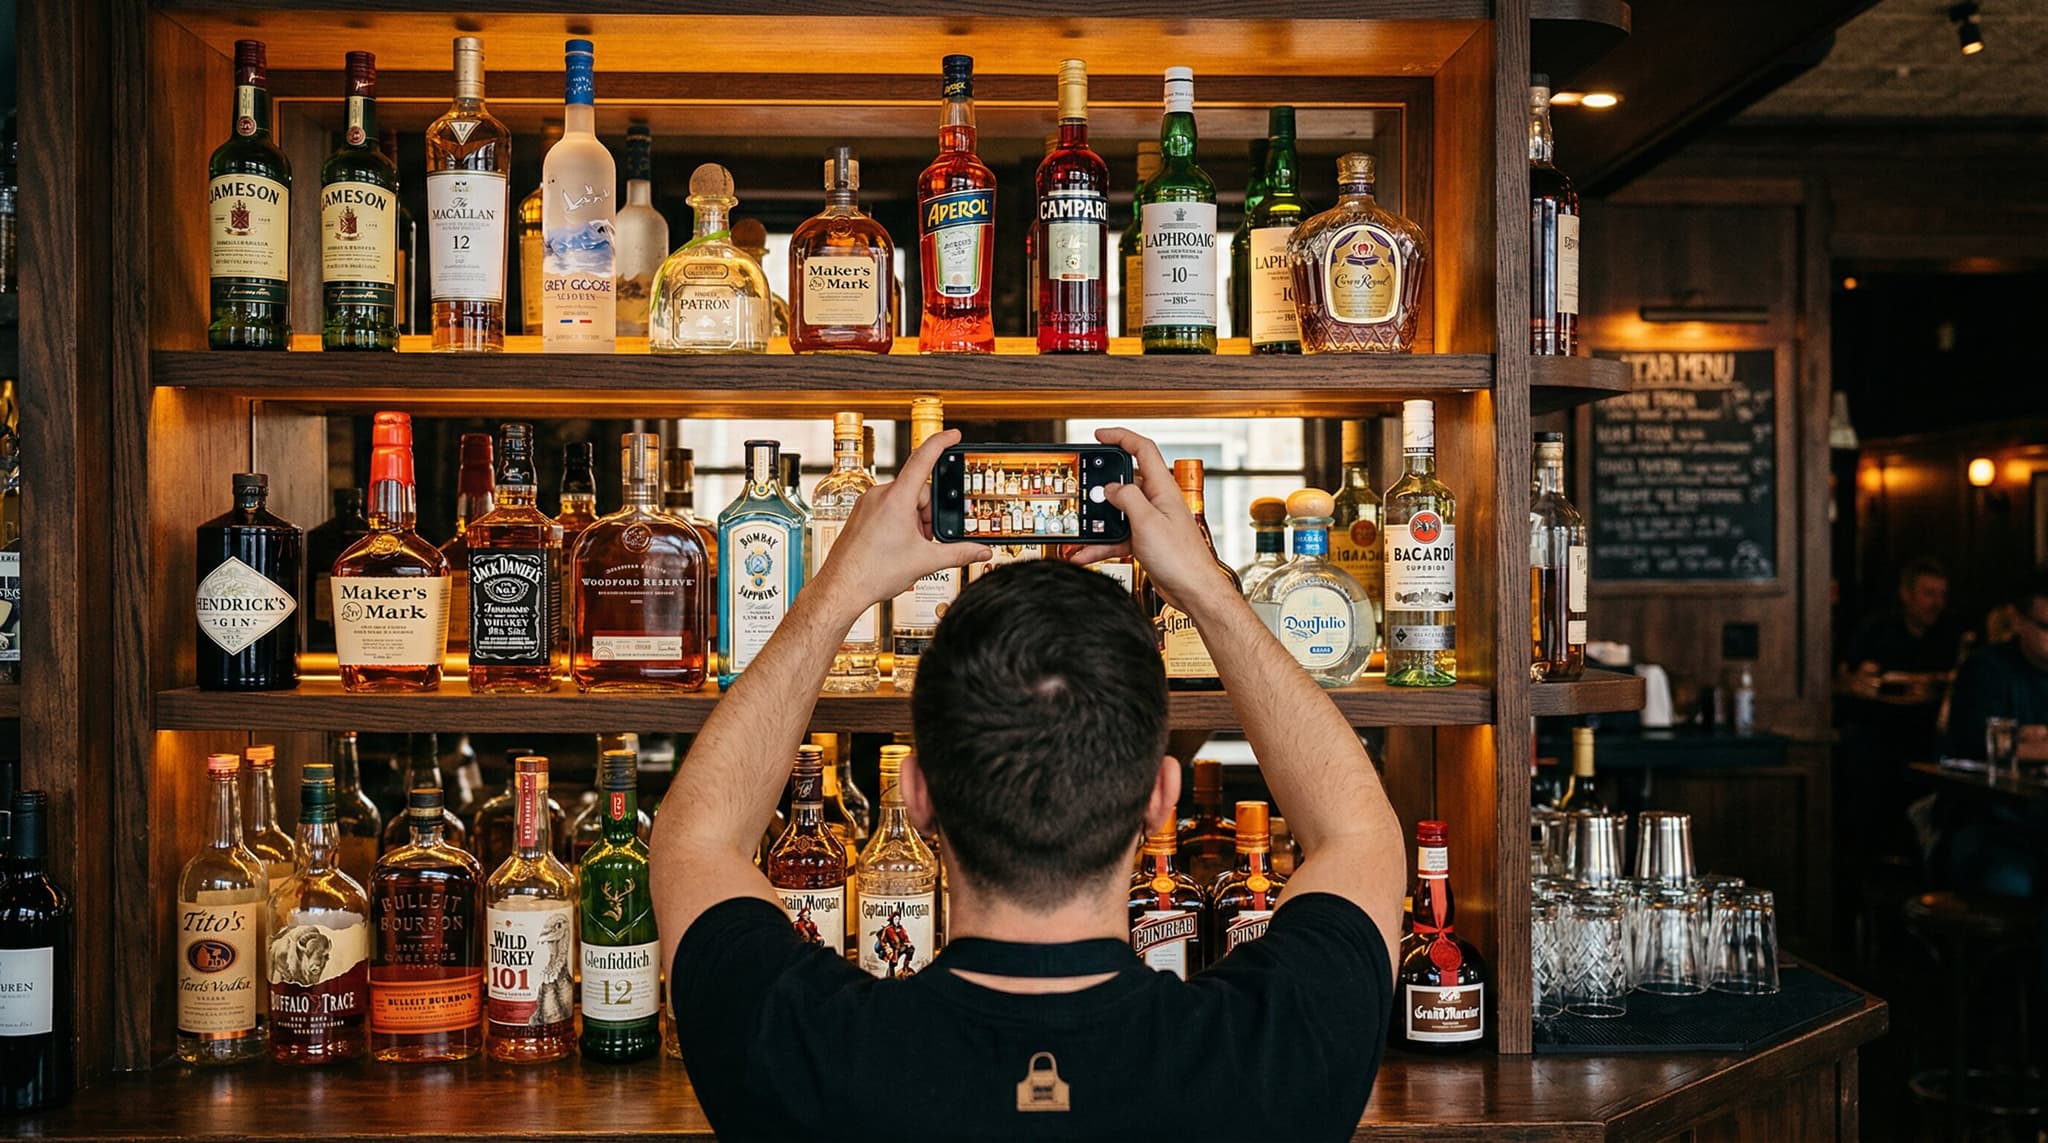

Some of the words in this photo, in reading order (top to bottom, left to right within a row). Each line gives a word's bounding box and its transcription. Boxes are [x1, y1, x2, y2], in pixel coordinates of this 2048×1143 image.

[209, 182, 280, 206] JAMESON
[321, 189, 387, 212] JAMESON
[431, 208, 495, 221] MACALLAN
[927, 198, 988, 228] APEROL
[1040, 199, 1107, 220] CAMPARI
[452, 235, 471, 250] 12
[1145, 231, 1214, 249] LAPHROAIG
[808, 265, 871, 277] Maker's
[1255, 255, 1288, 270] LAPH
[827, 278, 870, 289] Mark
[1172, 266, 1188, 283] 10
[544, 279, 567, 292] GREY
[571, 278, 611, 292] GOOSE
[740, 532, 779, 549] BOMBAY
[1394, 543, 1454, 561] BACARDÍ
[472, 561, 500, 583] JACK
[581, 578, 640, 587] WOODFORD
[643, 578, 693, 587] RESERVE
[341, 584, 428, 600] Maker's
[738, 585, 780, 601] SAPPHIRE
[196, 596, 286, 611] HENDRICK'S
[364, 604, 428, 620] Mark
[219, 617, 250, 627] GIN
[381, 892, 462, 913] BULLEIT
[862, 901, 894, 920] Captain
[894, 900, 929, 919] Morgan
[183, 909, 245, 932] Tito's
[493, 930, 527, 950] WILD
[489, 943, 535, 967] TURKEY
[584, 949, 650, 970] Glenfiddich
[491, 966, 530, 991] 101
[600, 978, 633, 1006] 12
[321, 991, 355, 1014] TRACE
